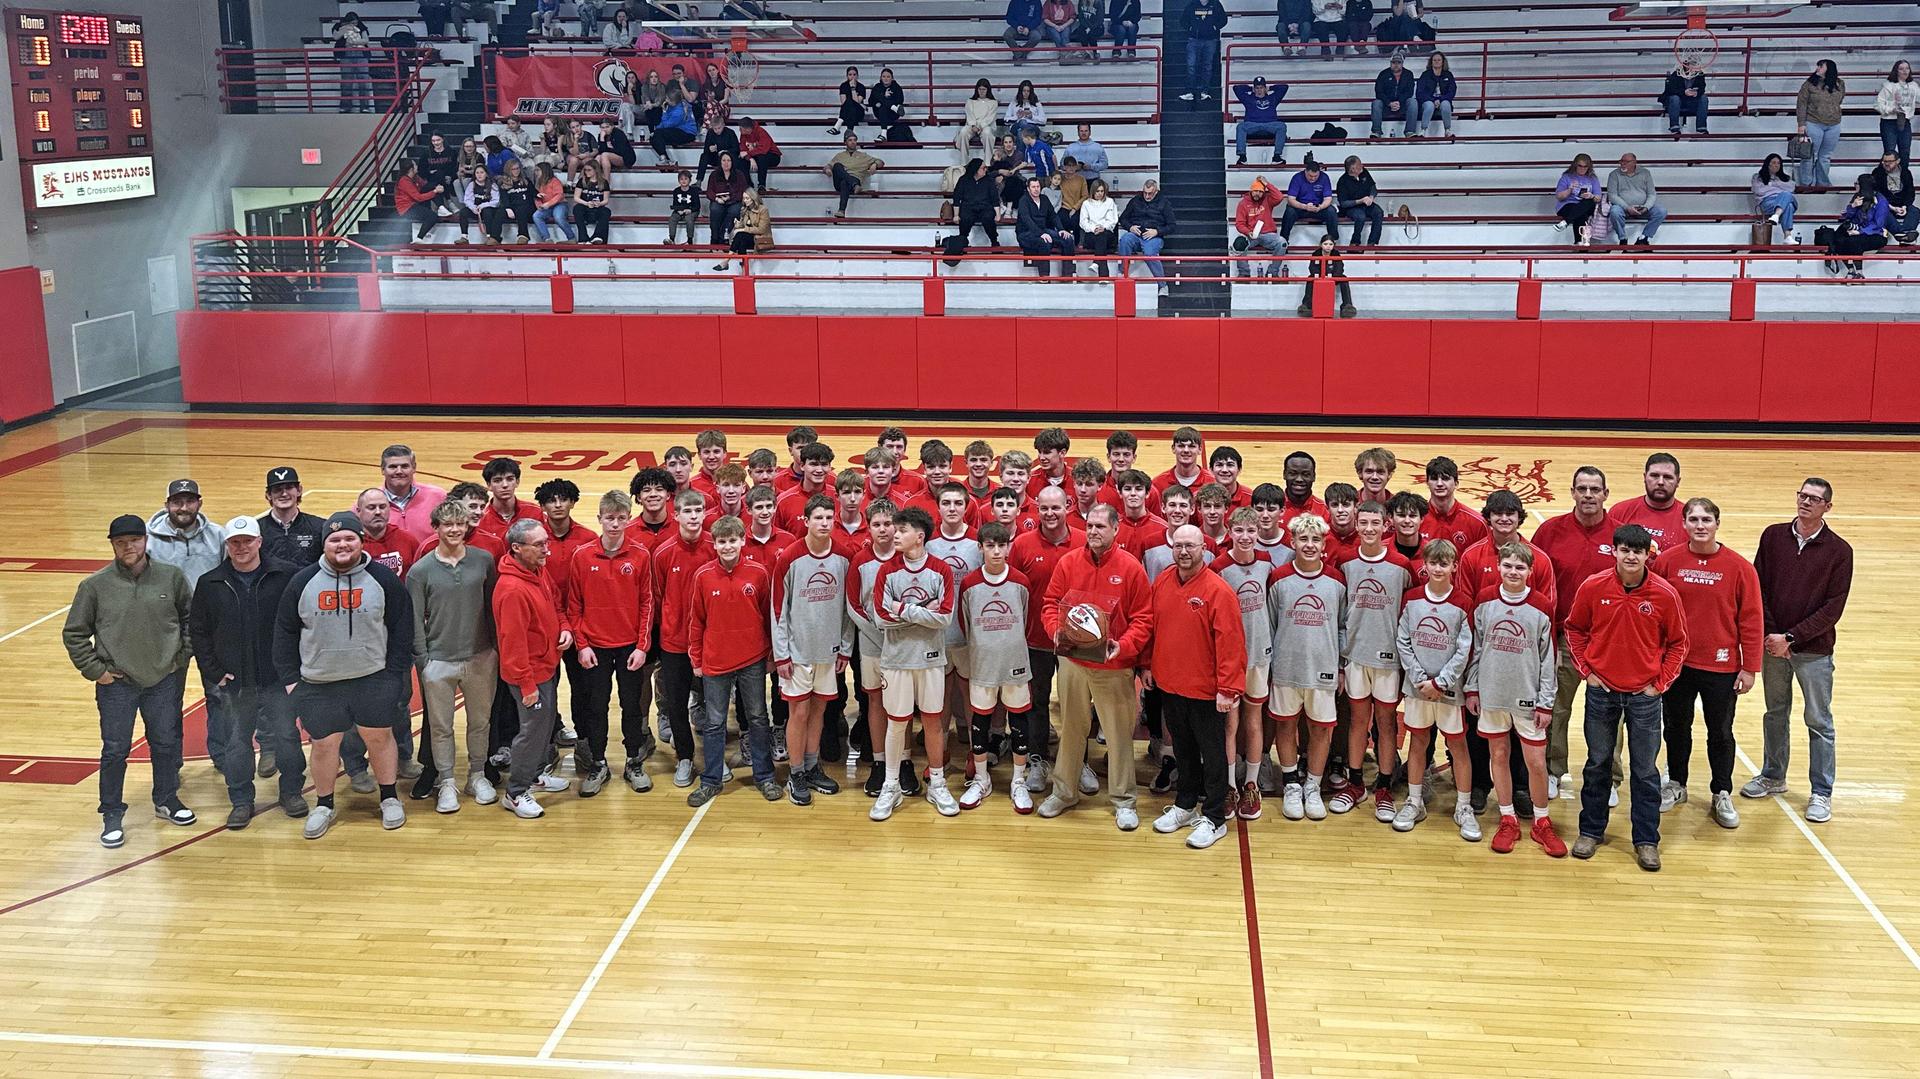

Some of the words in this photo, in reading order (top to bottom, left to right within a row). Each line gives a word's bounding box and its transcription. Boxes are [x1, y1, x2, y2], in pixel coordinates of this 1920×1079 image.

[20, 15, 45, 29] Home
[115, 20, 141, 34] Guests
[74, 67, 99, 81] period
[30, 90, 50, 103] fouls
[76, 89, 101, 103] player
[126, 89, 142, 101] fouls
[37, 141, 53, 151] won
[131, 137, 145, 146] won
[64, 170, 90, 184] EJHS
[92, 166, 151, 181] MUSTANGS
[87, 184, 124, 196] Crossroads
[125, 183, 141, 192] Bank
[1684, 576, 1714, 584] HEARTS
[319, 588, 363, 610] GU
